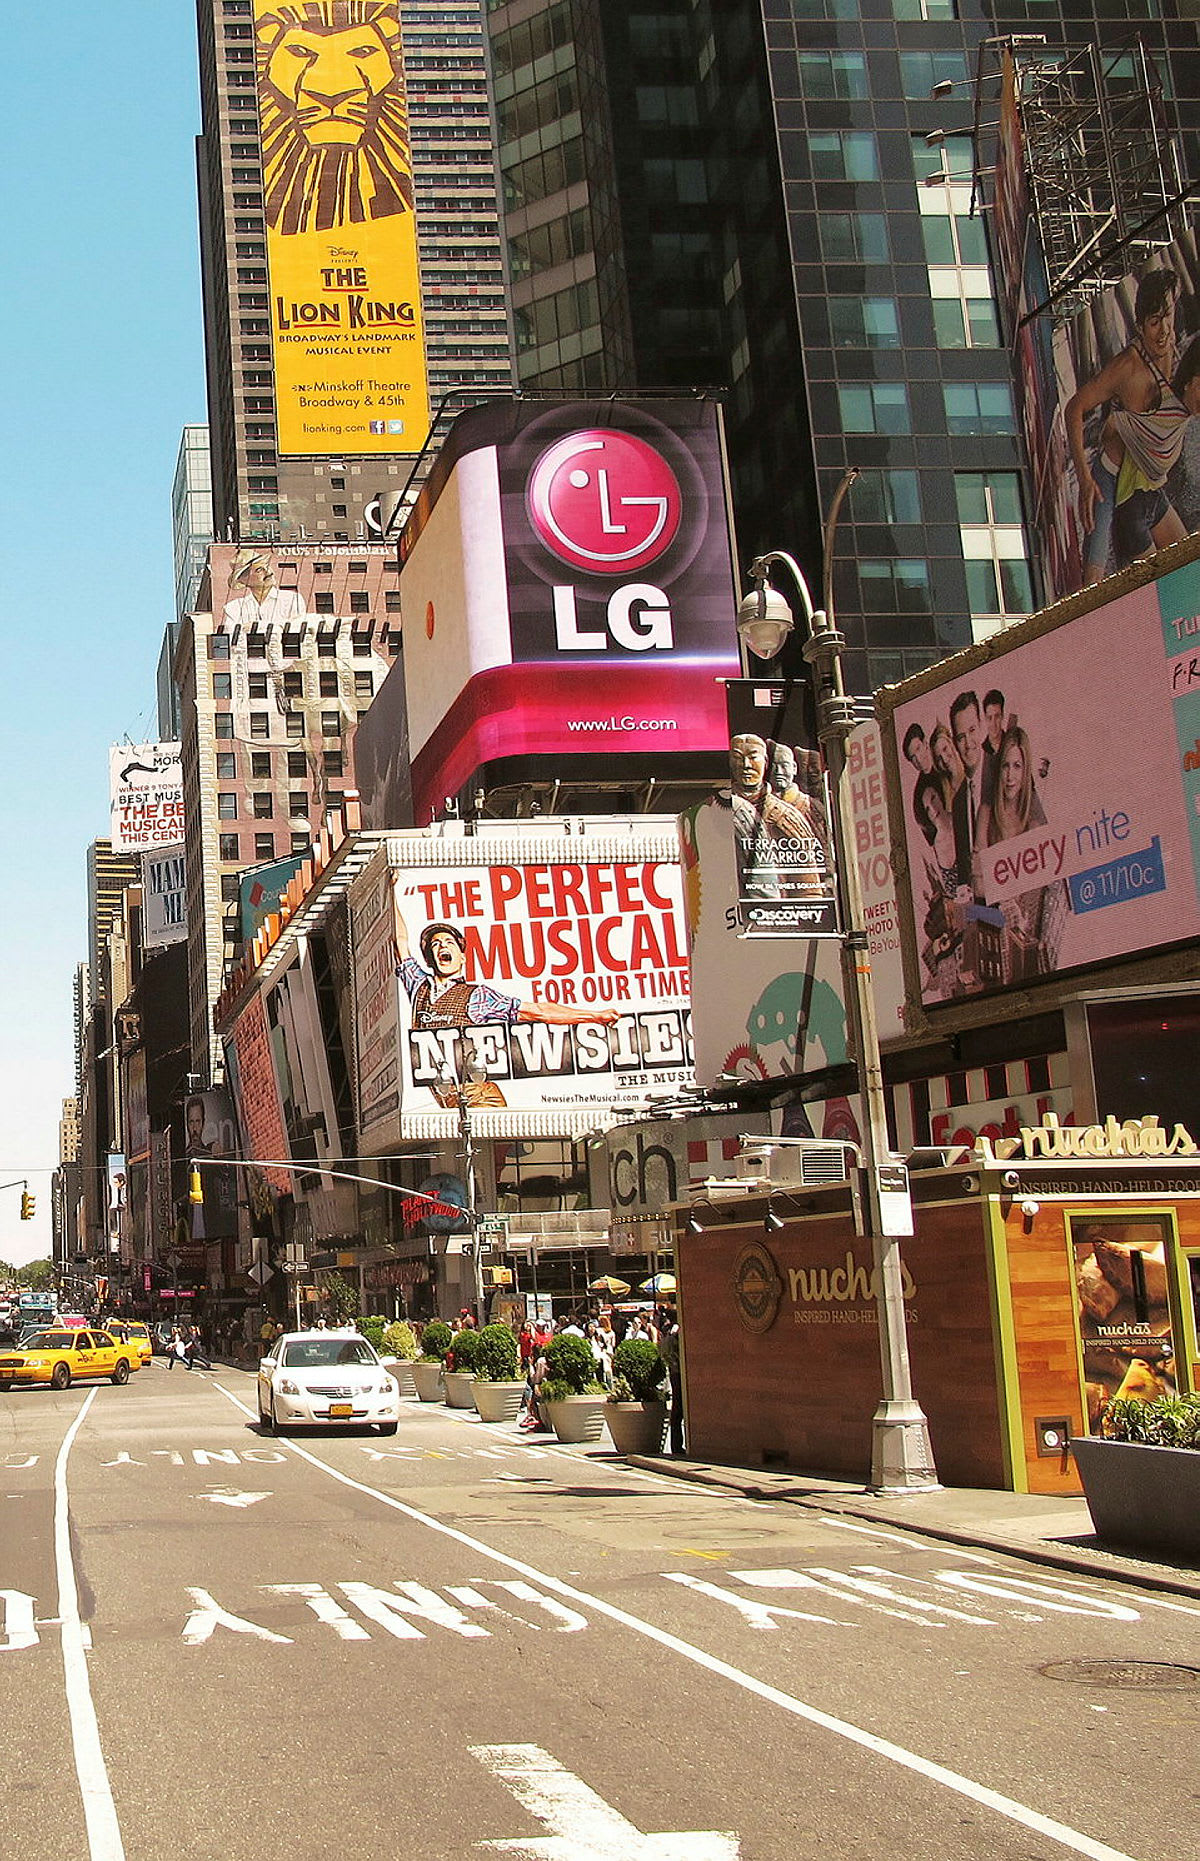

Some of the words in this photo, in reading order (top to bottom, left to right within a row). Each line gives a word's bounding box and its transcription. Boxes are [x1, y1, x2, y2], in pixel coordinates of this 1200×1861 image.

[327, 245, 358, 258] Disney
[321, 268, 367, 287] THE
[277, 297, 340, 330] LION
[348, 295, 414, 329] KING
[279, 333, 349, 343] BROADWAY'S
[351, 333, 416, 342] LANDMARK
[305, 347, 354, 355] MUSICAL
[357, 346, 392, 354] EVENT
[313, 380, 364, 391] Minskoff
[367, 379, 411, 391] Theatre
[299, 397, 360, 408] Broadway
[365, 396, 374, 407] &
[378, 396, 406, 406] 45th
[302, 423, 366, 433] lionking.com
[314, 545, 390, 556] Colombian
[553, 583, 674, 651] LG
[567, 717, 677, 731] www.LG.com
[850, 734, 876, 774] BE
[119, 793, 150, 804] BEST
[155, 790, 182, 801] MUS
[852, 773, 883, 814] HE
[163, 802, 185, 817] BE
[120, 818, 186, 833] MUSICAL
[120, 833, 149, 843] THIS
[152, 830, 186, 841] CENT
[856, 814, 885, 855] BE
[741, 837, 823, 850] TERRACOTTA
[993, 834, 1066, 886] every
[1075, 809, 1131, 855] nite
[755, 850, 825, 863] WARRIORS
[858, 856, 890, 893] YO
[488, 863, 682, 921] PERFEC
[751, 908, 823, 923] Discovery
[462, 912, 689, 982] MUSICAL
[532, 976, 577, 1005] FOR
[582, 973, 632, 1002] OUR
[637, 970, 692, 1000] TIME
[415, 1011, 455, 1025] Disney
[618, 1074, 650, 1087] THE
[653, 1070, 696, 1083] MUSI
[541, 1093, 640, 1103] NewsiesTheMusical.com
[1019, 1112, 1197, 1158] nuchas
[1018, 1180, 1079, 1194] INSPIRED
[1082, 1179, 1165, 1193] HAND-HELD
[831, 1309, 878, 1324] HAND-HEL
[1097, 1321, 1152, 1336] nuchas
